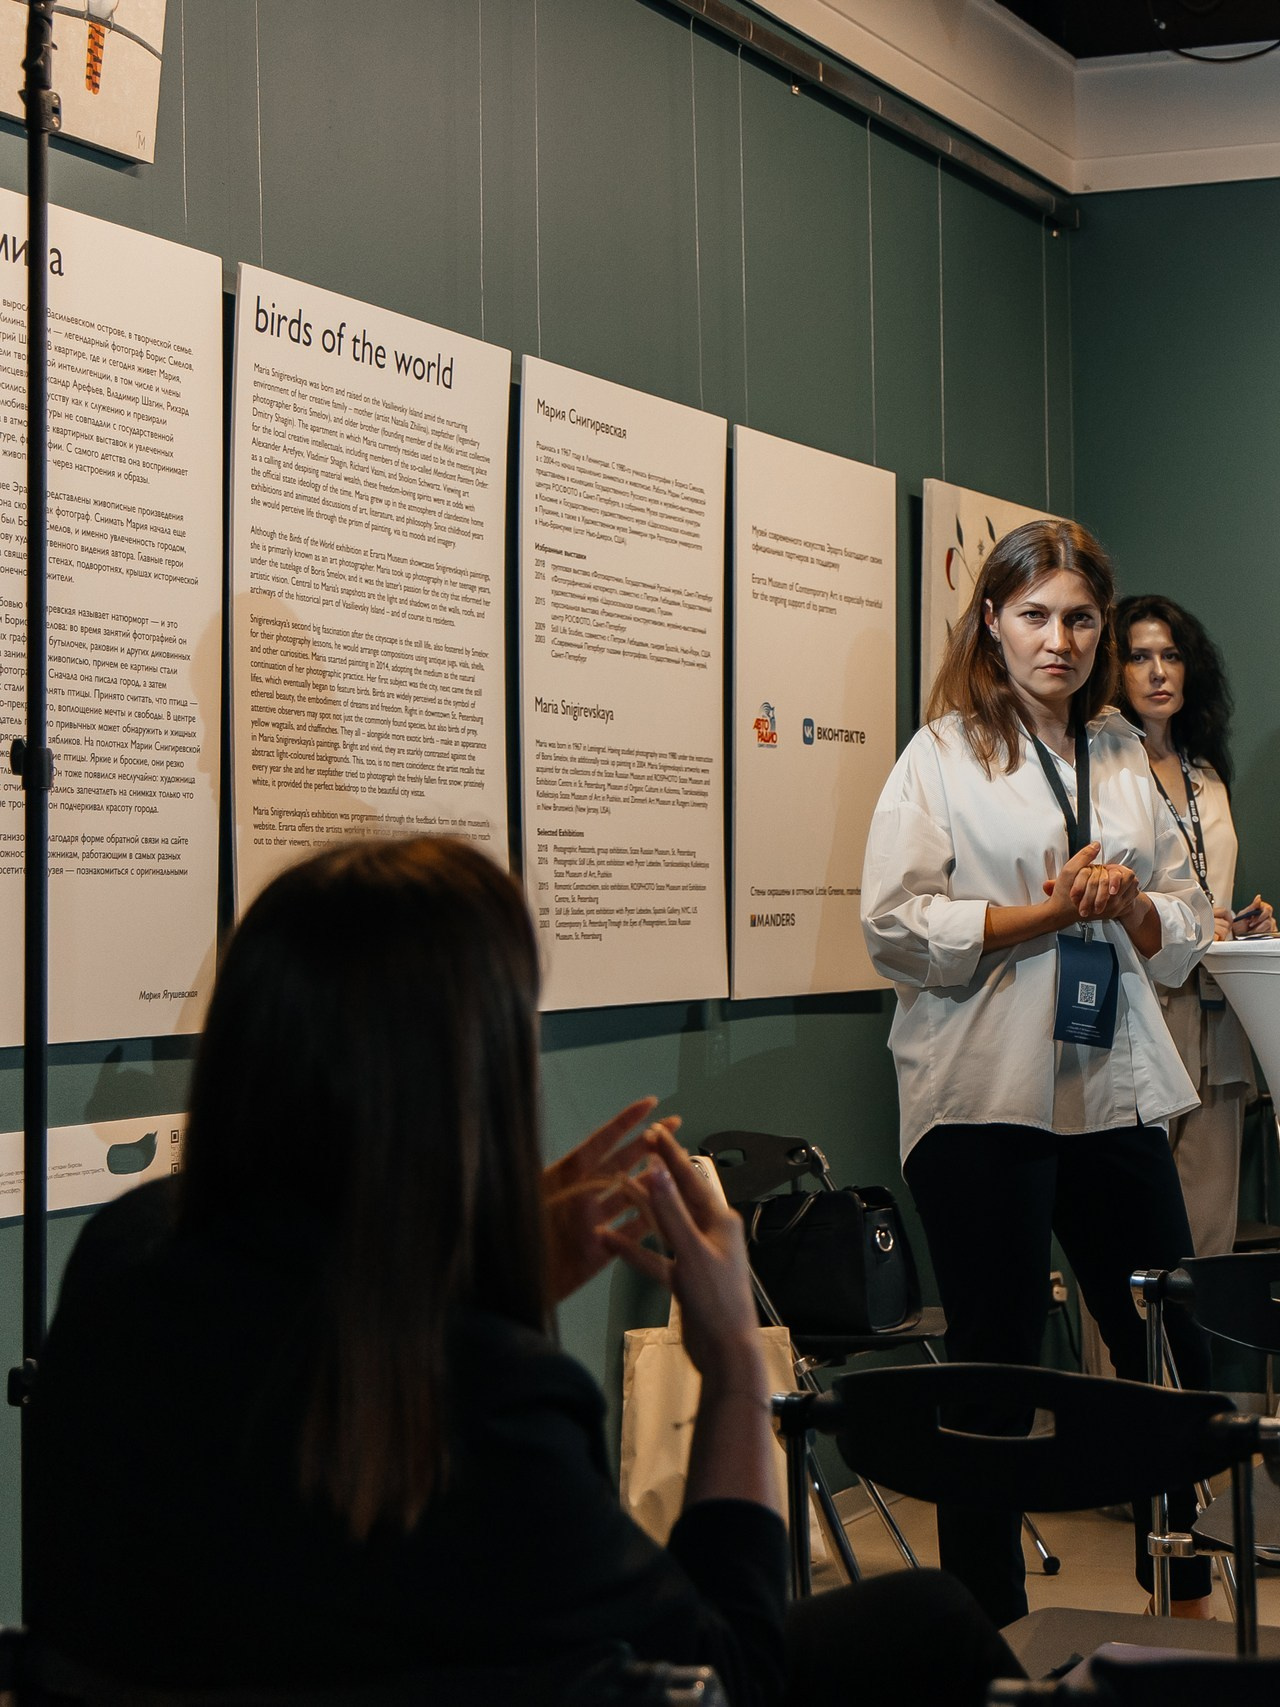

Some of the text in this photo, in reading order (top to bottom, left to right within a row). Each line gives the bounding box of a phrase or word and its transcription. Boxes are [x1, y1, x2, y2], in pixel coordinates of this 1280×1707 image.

[64, 332, 109, 349] легендарный
[110, 341, 144, 360] фотограф
[146, 349, 166, 364] Борис
[134, 333, 171, 349] творческой
[255, 295, 453, 389] birds of the world
[90, 354, 100, 363] где
[108, 358, 135, 371] сегодня
[137, 366, 157, 376] живет
[107, 387, 140, 406] Владимир
[166, 401, 189, 416] Рихард
[537, 398, 626, 439] Мария Снигиревская
[94, 512, 124, 526] Снимать
[126, 518, 148, 532] Мария
[149, 525, 171, 535] начала
[172, 529, 186, 538] еще
[126, 568, 152, 578] крышах
[154, 572, 198, 585] исторической
[535, 696, 614, 724] Maria Snigirevskaya
[84, 736, 94, 746] На
[96, 740, 128, 748] полотнах
[130, 739, 152, 752] Марии
[154, 741, 200, 754] Снигиревской
[136, 868, 188, 878] оригинальными
[756, 912, 795, 927] MANDERS
[139, 989, 198, 1002] Мария Ягушевская
